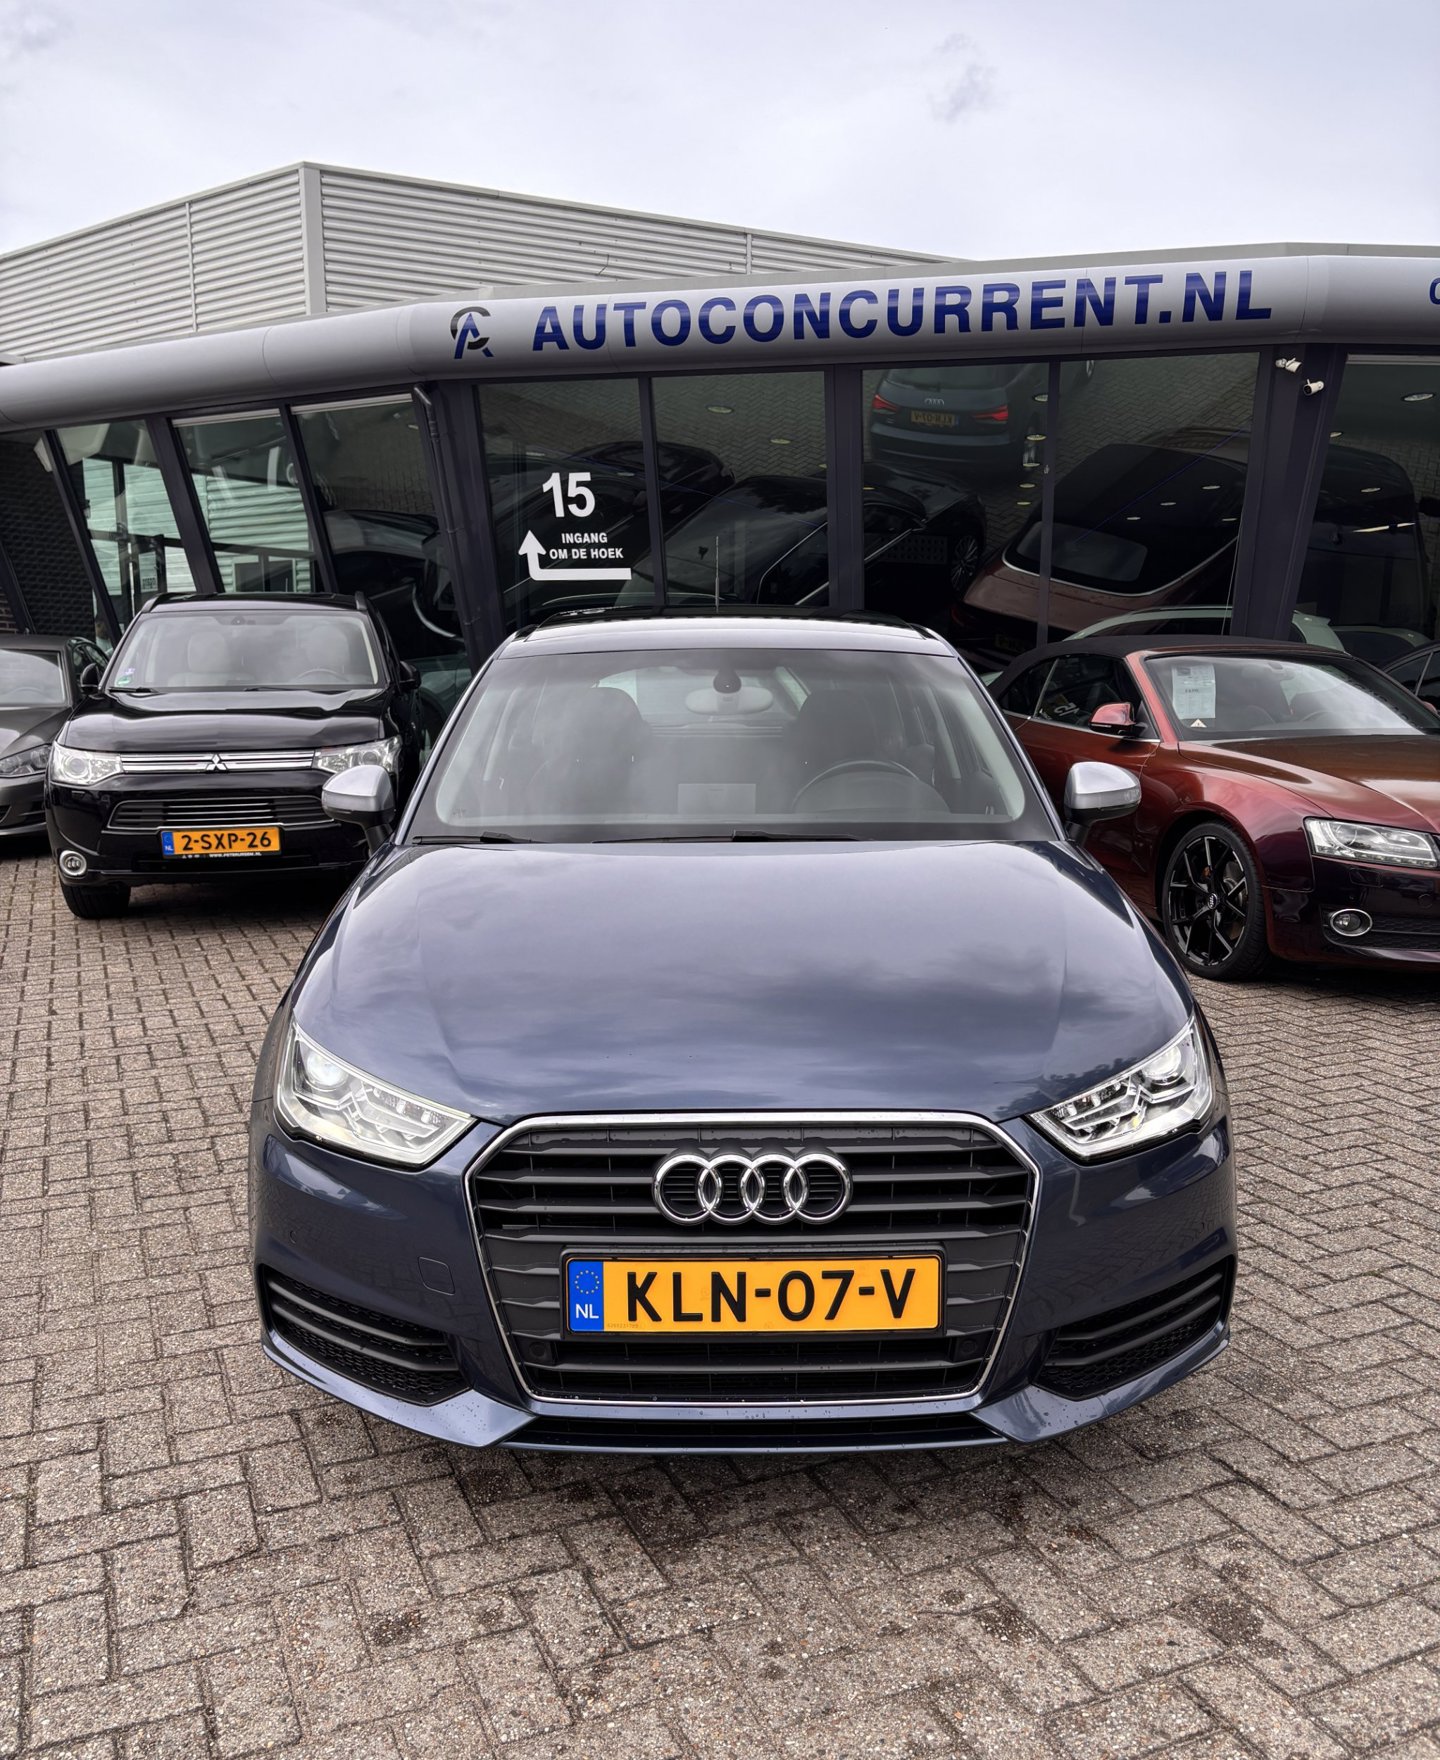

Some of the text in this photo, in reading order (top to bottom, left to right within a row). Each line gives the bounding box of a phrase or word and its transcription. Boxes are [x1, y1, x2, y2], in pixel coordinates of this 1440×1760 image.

[532, 270, 1272, 351] AUTOCONCURRENT.NL
[542, 472, 596, 517] 15
[561, 532, 608, 544] INGANG
[549, 547, 624, 559] OM DE HOEK
[181, 831, 272, 851] 2-SXP-26
[627, 1268, 916, 1322] KLN-07-V
[575, 1303, 600, 1319] NL
